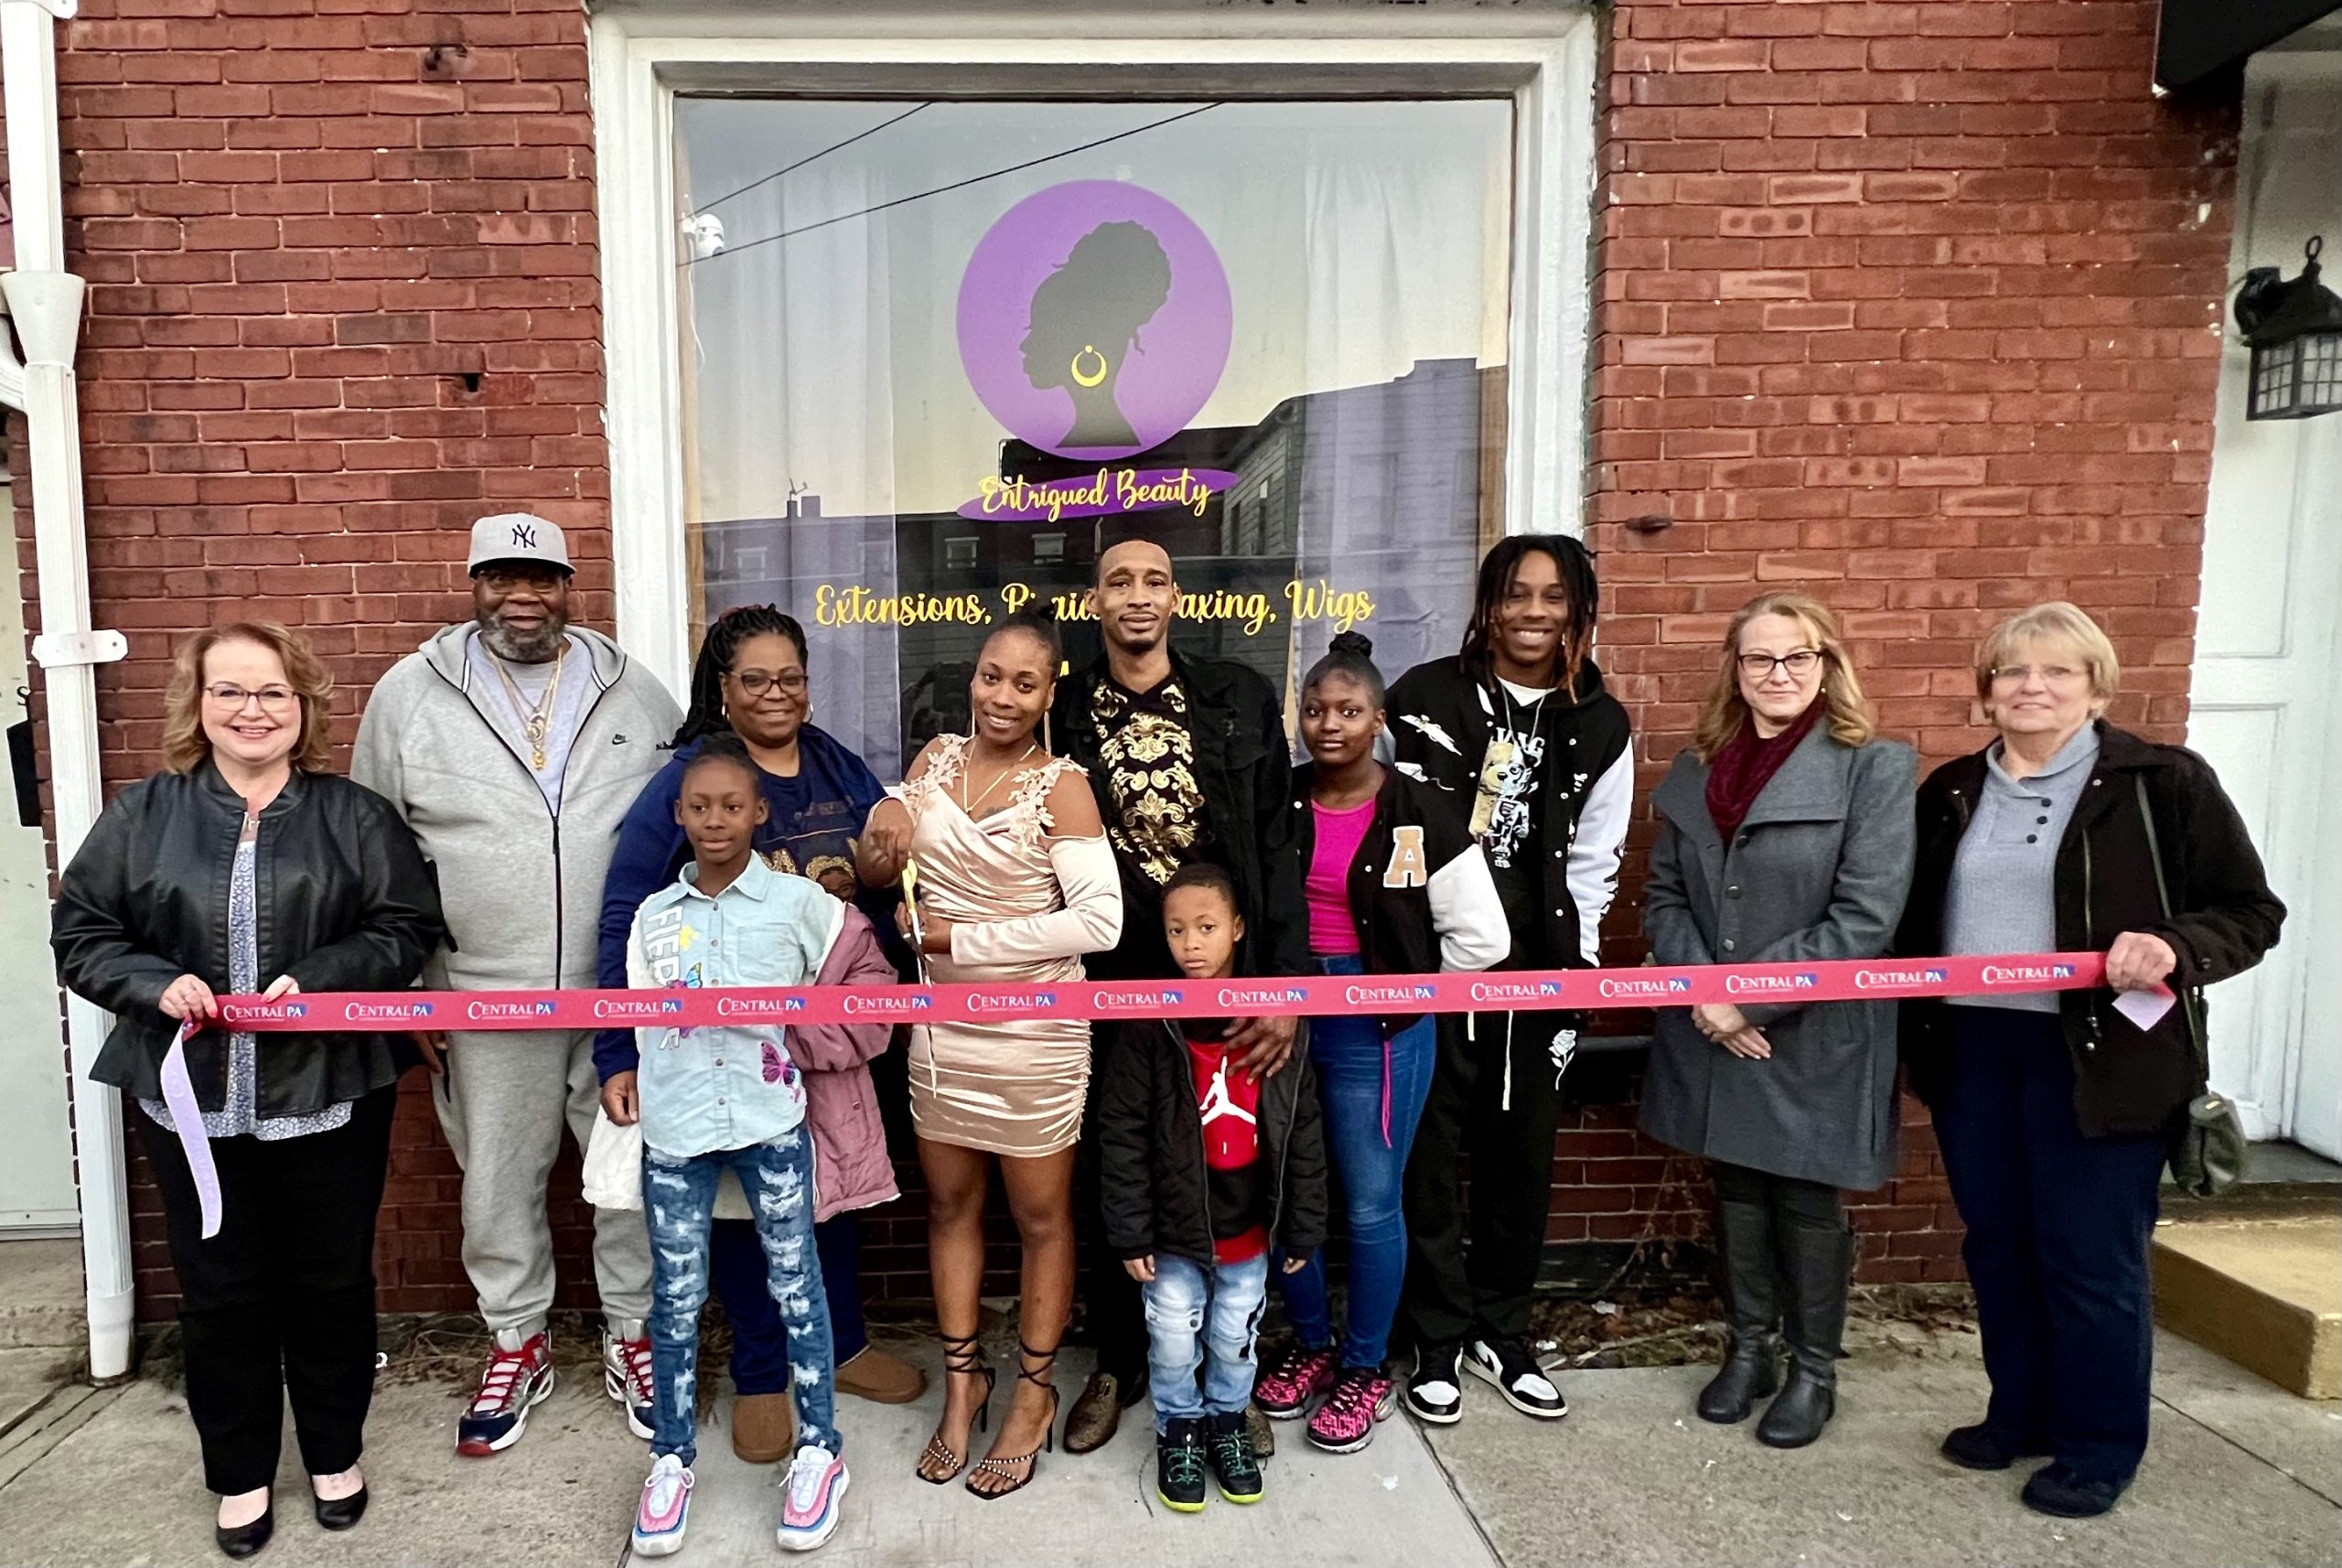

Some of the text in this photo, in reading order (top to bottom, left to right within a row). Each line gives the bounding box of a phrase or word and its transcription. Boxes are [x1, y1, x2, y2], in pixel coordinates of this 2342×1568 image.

[979, 467, 1213, 522] Entrigued Beauty
[814, 583, 993, 628] Extensions,
[1172, 582, 1277, 634] axing,
[1284, 579, 1376, 634] Wigs
[1383, 825, 1427, 888] A
